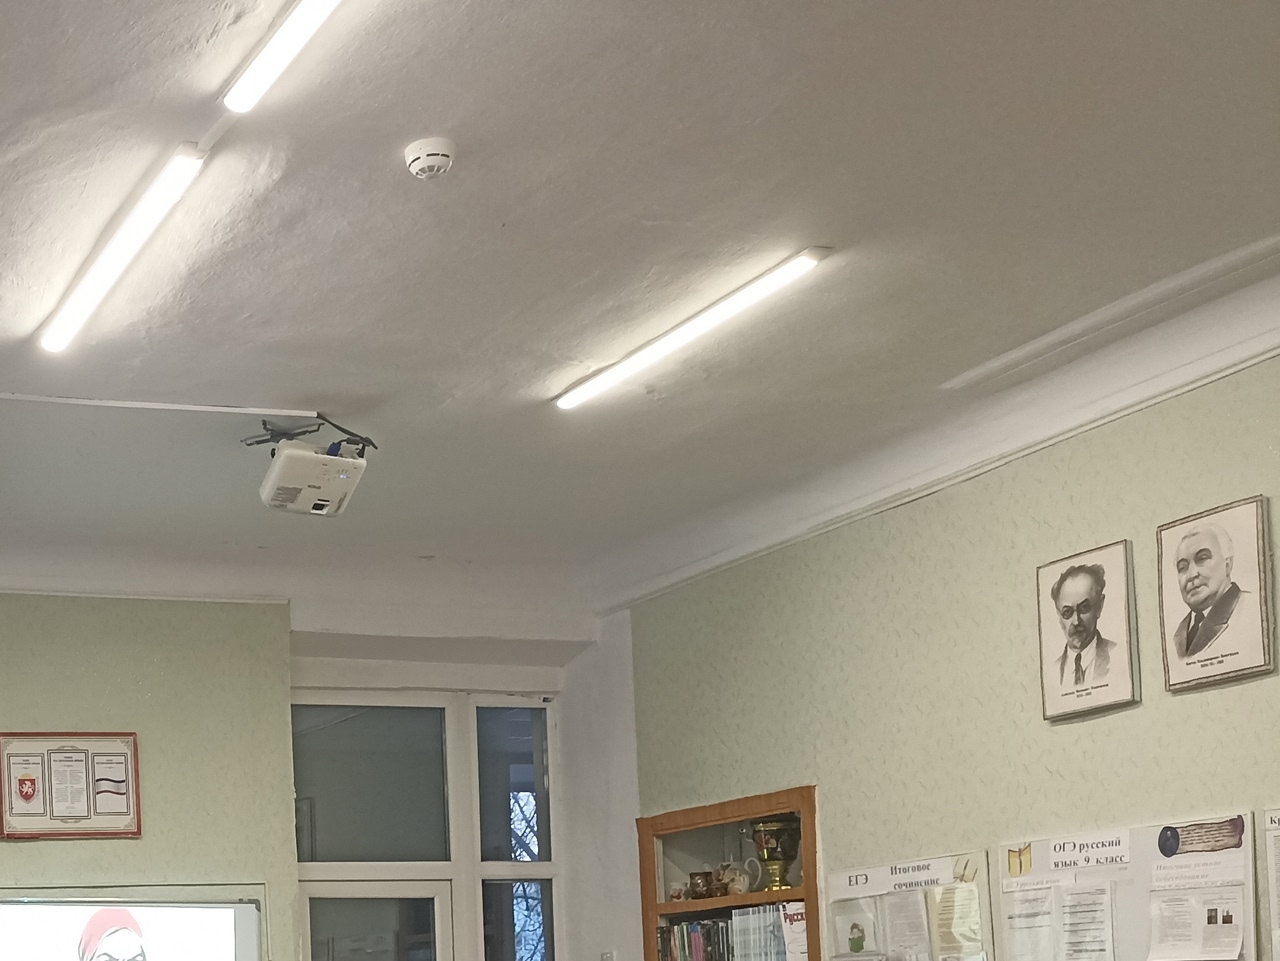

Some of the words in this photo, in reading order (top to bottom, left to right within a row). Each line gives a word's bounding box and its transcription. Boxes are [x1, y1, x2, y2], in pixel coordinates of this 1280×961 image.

[1053, 841, 1077, 854] ОГЭ
[1079, 836, 1121, 854] русский
[1053, 858, 1080, 869] язык
[1084, 855, 1091, 865] 9
[1095, 854, 1126, 865] класс
[890, 863, 932, 876] Итоговое
[848, 873, 869, 887] ЕГЭ
[893, 877, 940, 891] сочинение
